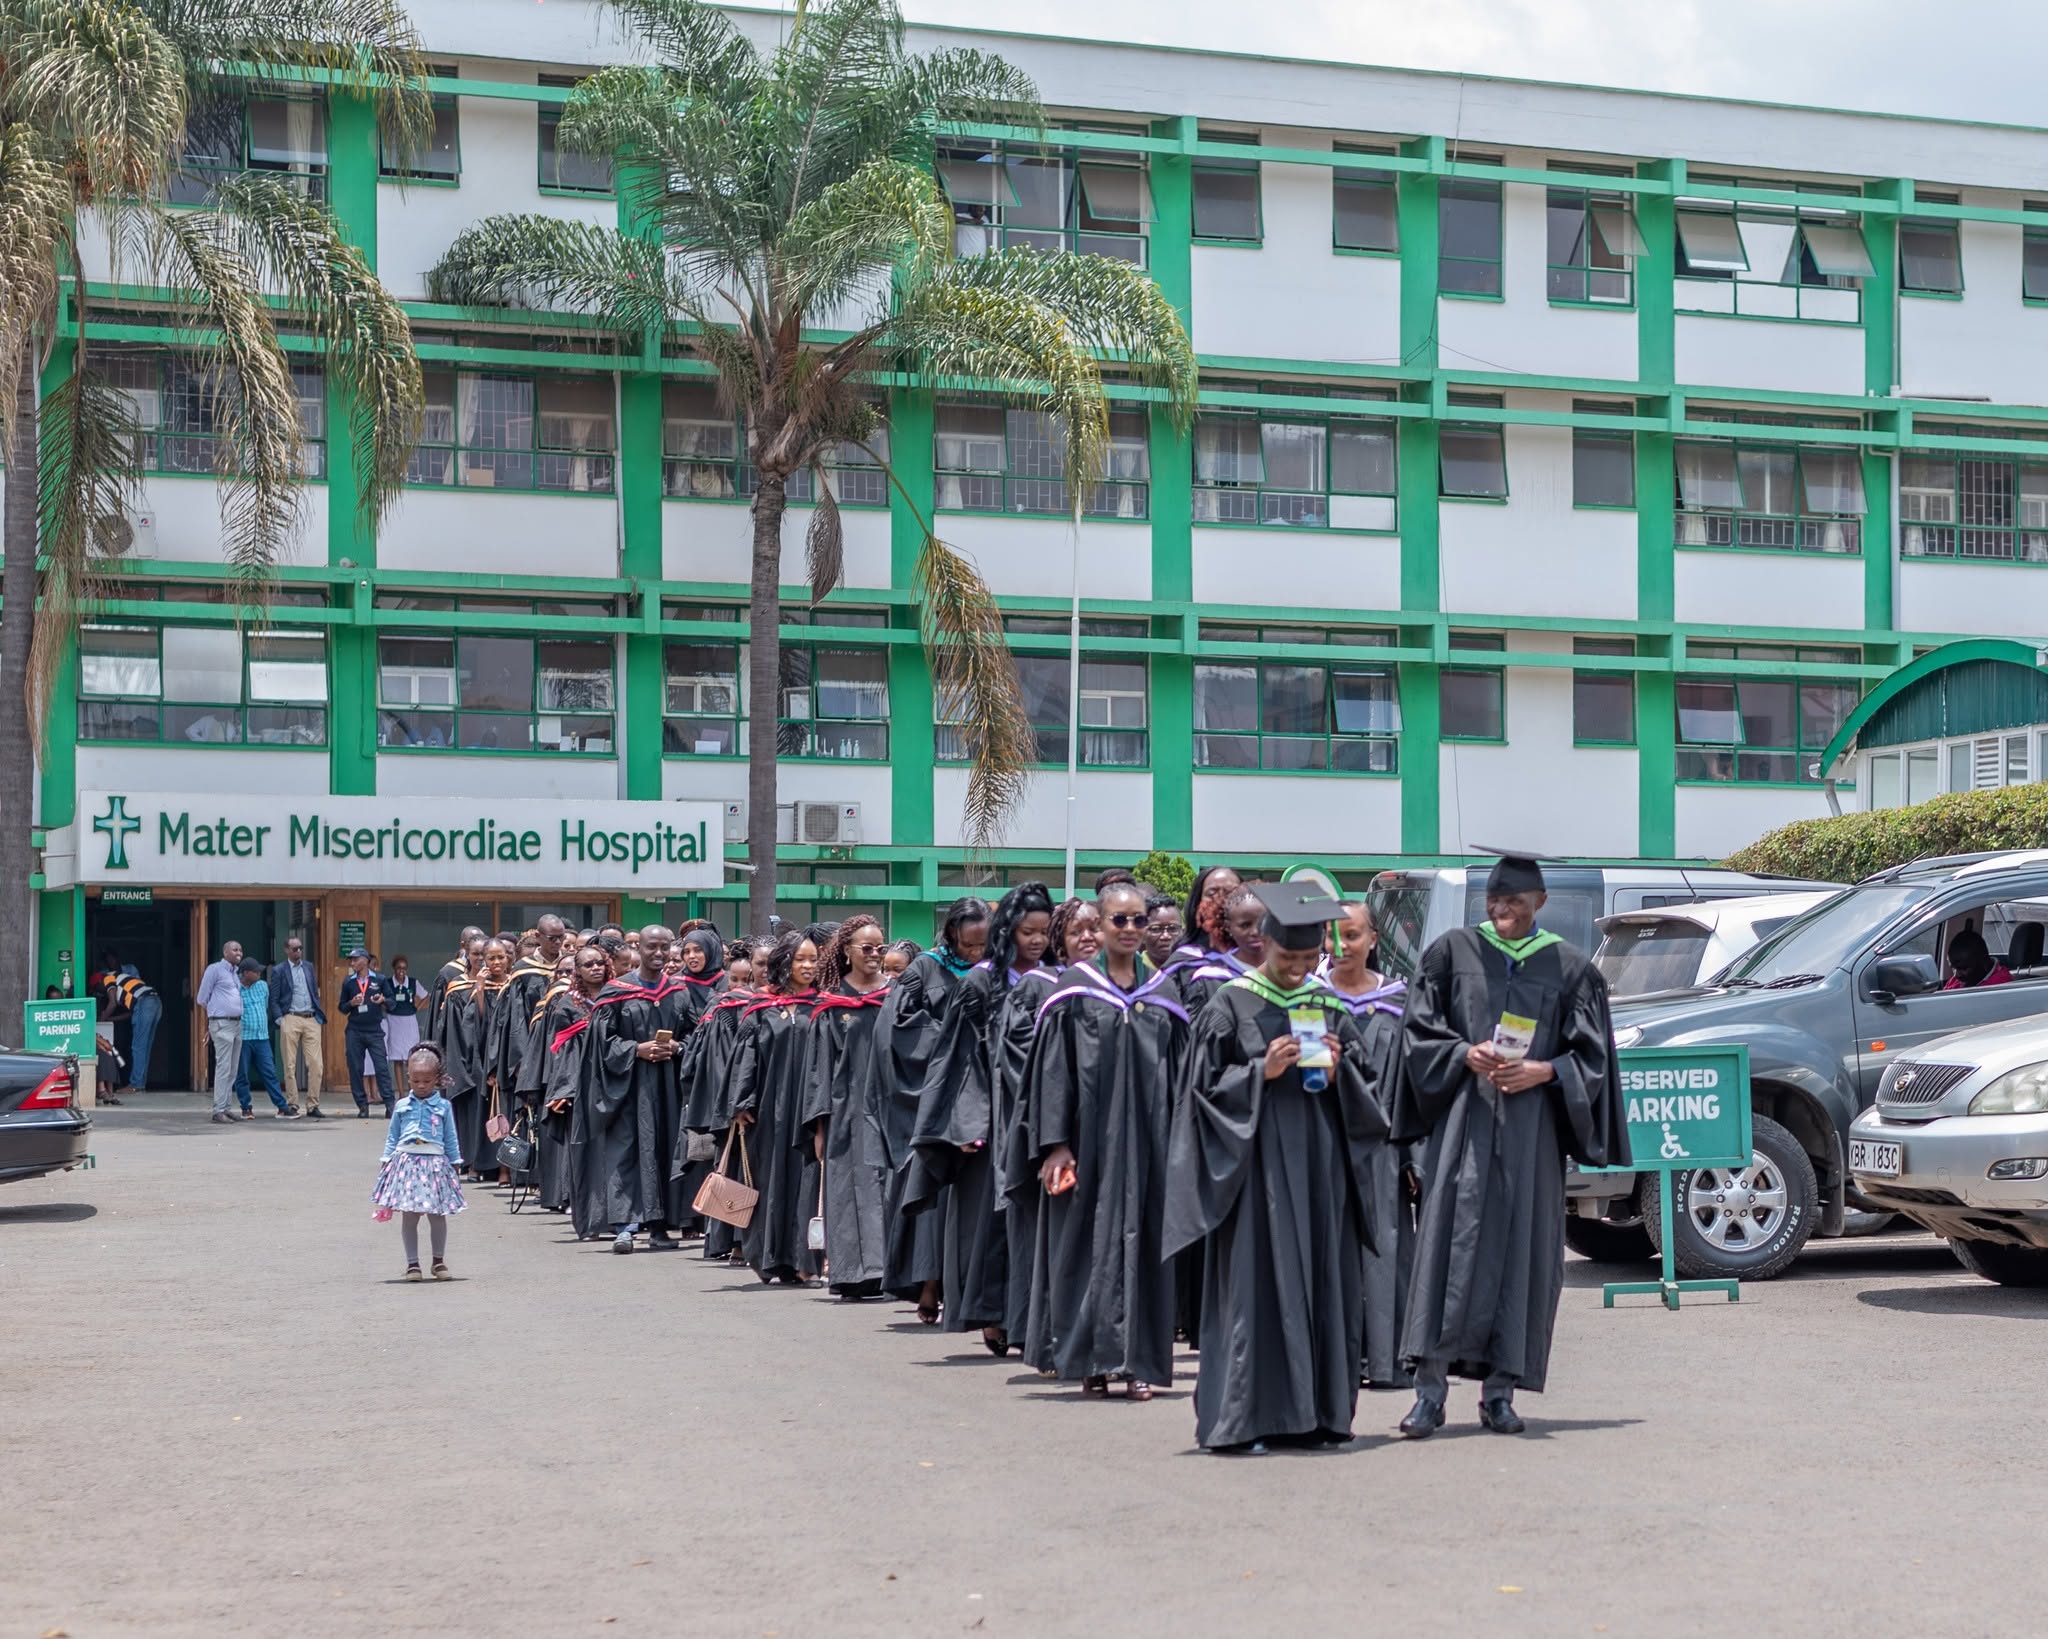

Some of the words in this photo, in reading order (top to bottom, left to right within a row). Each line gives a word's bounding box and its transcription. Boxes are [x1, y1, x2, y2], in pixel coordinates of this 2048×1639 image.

[159, 812, 271, 857] Mater
[290, 814, 541, 861] Misericordiae
[561, 819, 706, 874] Hospital
[103, 891, 151, 900] ENTRANCE
[34, 1009, 86, 1022] RESERVED
[39, 1024, 81, 1036] PARKING
[1619, 1069, 1718, 1091] ESERVED
[1627, 1094, 1720, 1123] ARKING
[1873, 1145, 1897, 1170] 183C
